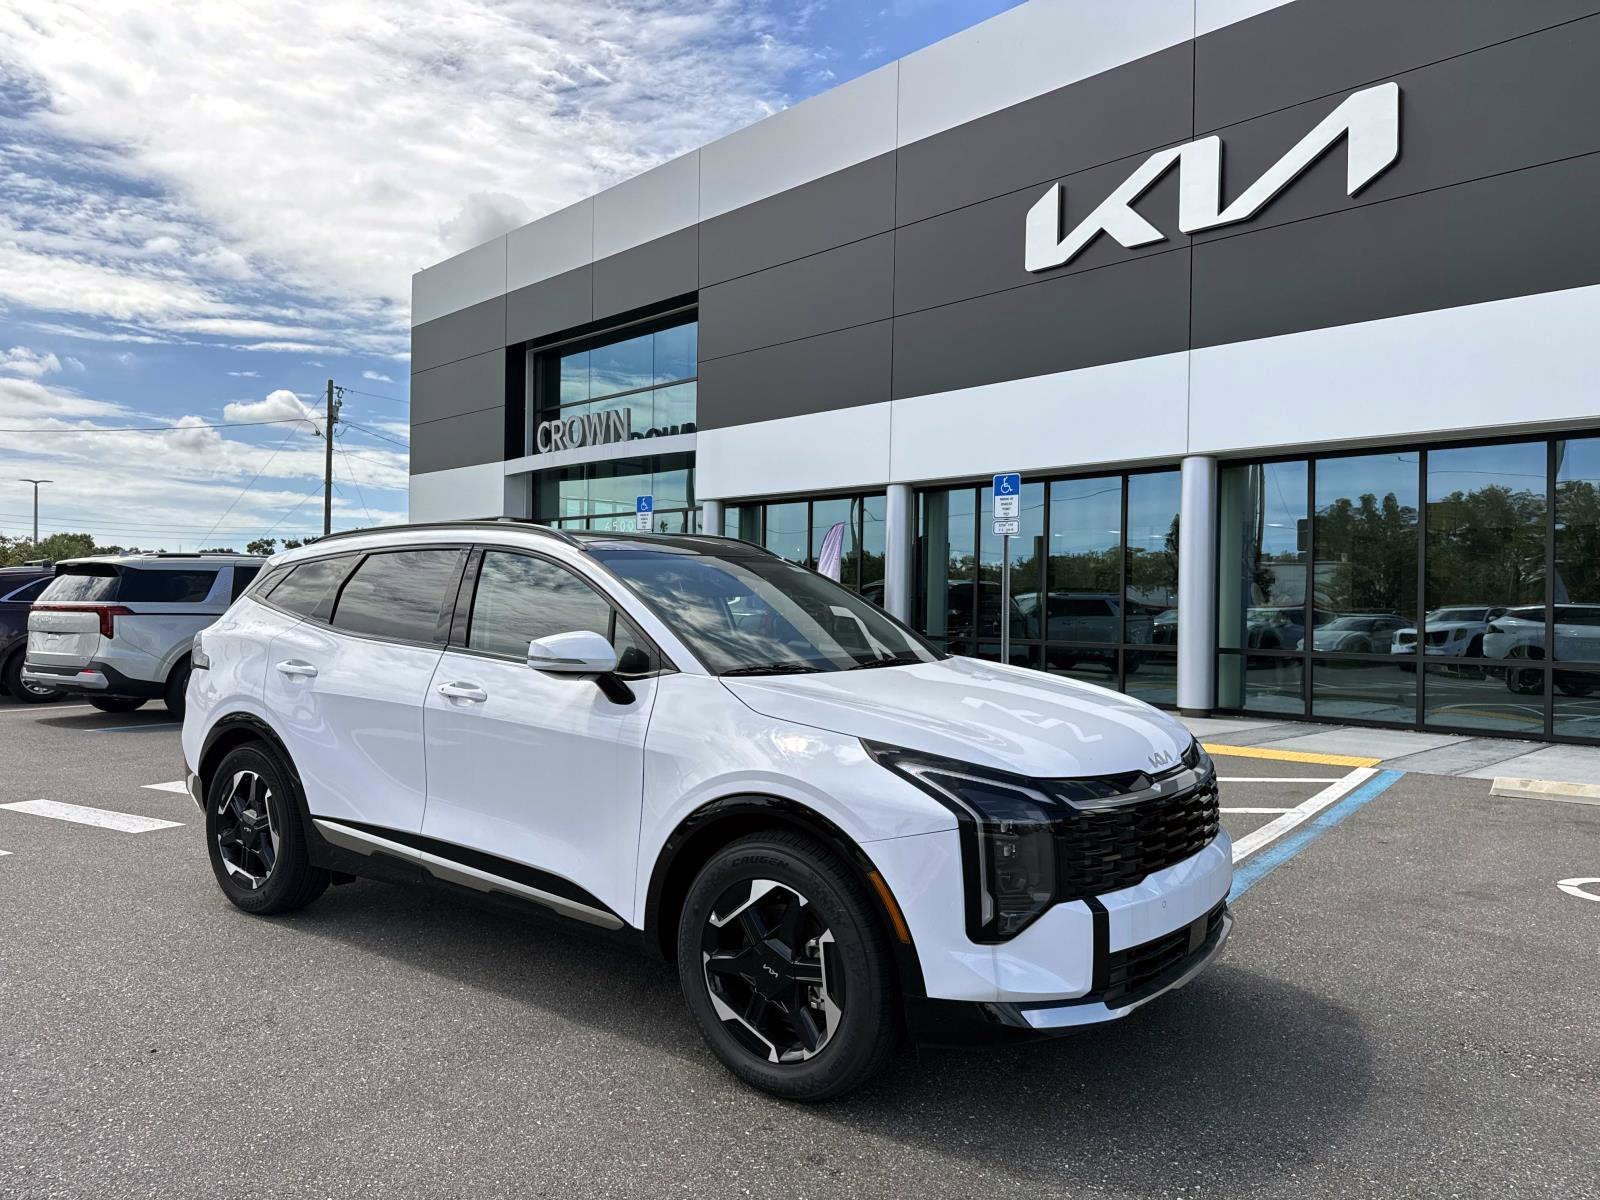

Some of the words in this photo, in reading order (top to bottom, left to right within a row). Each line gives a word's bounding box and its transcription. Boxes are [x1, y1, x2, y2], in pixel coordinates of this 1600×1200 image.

[1025, 82, 1399, 272] KIA
[536, 408, 632, 453] CROWN
[1147, 750, 1174, 768] KIA
